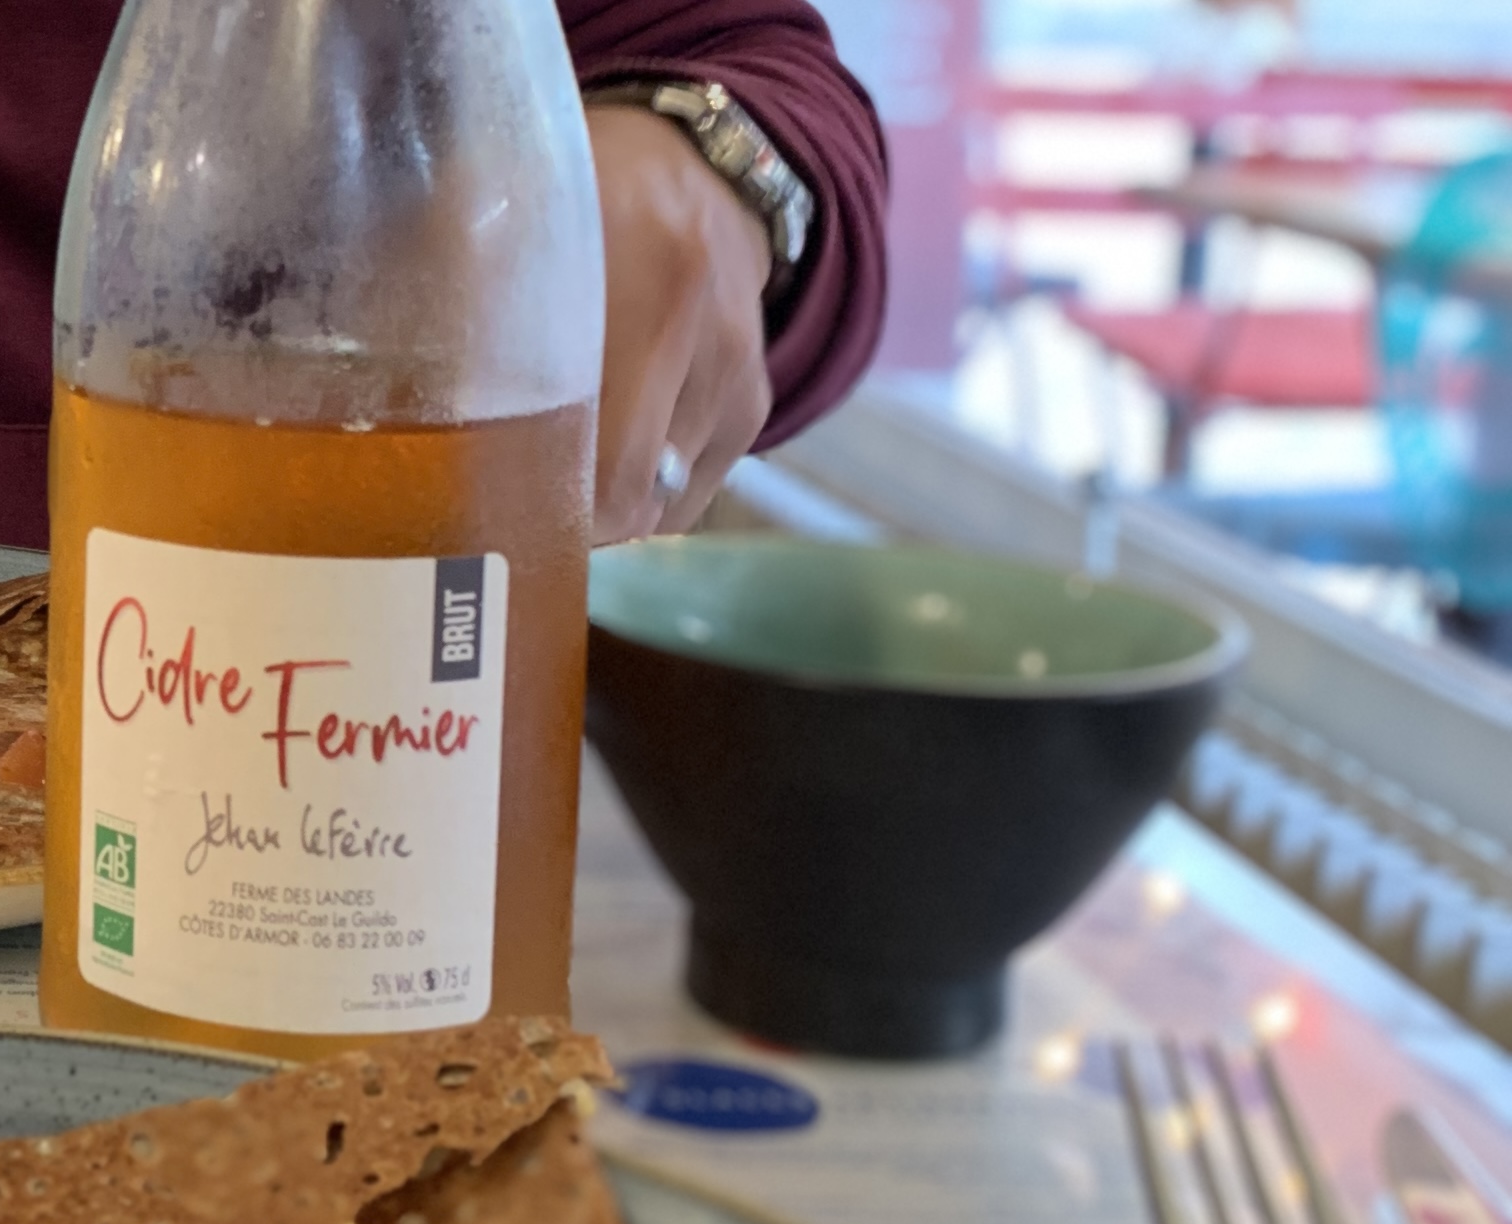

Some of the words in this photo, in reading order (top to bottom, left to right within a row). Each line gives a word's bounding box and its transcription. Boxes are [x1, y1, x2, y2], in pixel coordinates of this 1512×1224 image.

[441, 589, 477, 663] BRUT
[98, 596, 253, 725] Cidre
[262, 659, 479, 789] Fermier
[96, 843, 129, 883] AB
[209, 900, 255, 921] 22380
[232, 882, 278, 902] FERME
[283, 887, 312, 905] DES
[316, 888, 375, 907] LANDES
[179, 914, 225, 938] CÔTES
[229, 924, 299, 947] D'ARMOR
[312, 931, 332, 949] 06
[337, 932, 356, 949] 83
[361, 931, 380, 949] 22
[383, 930, 404, 948] 00
[407, 929, 425, 946] 09
[444, 966, 458, 989] 75
